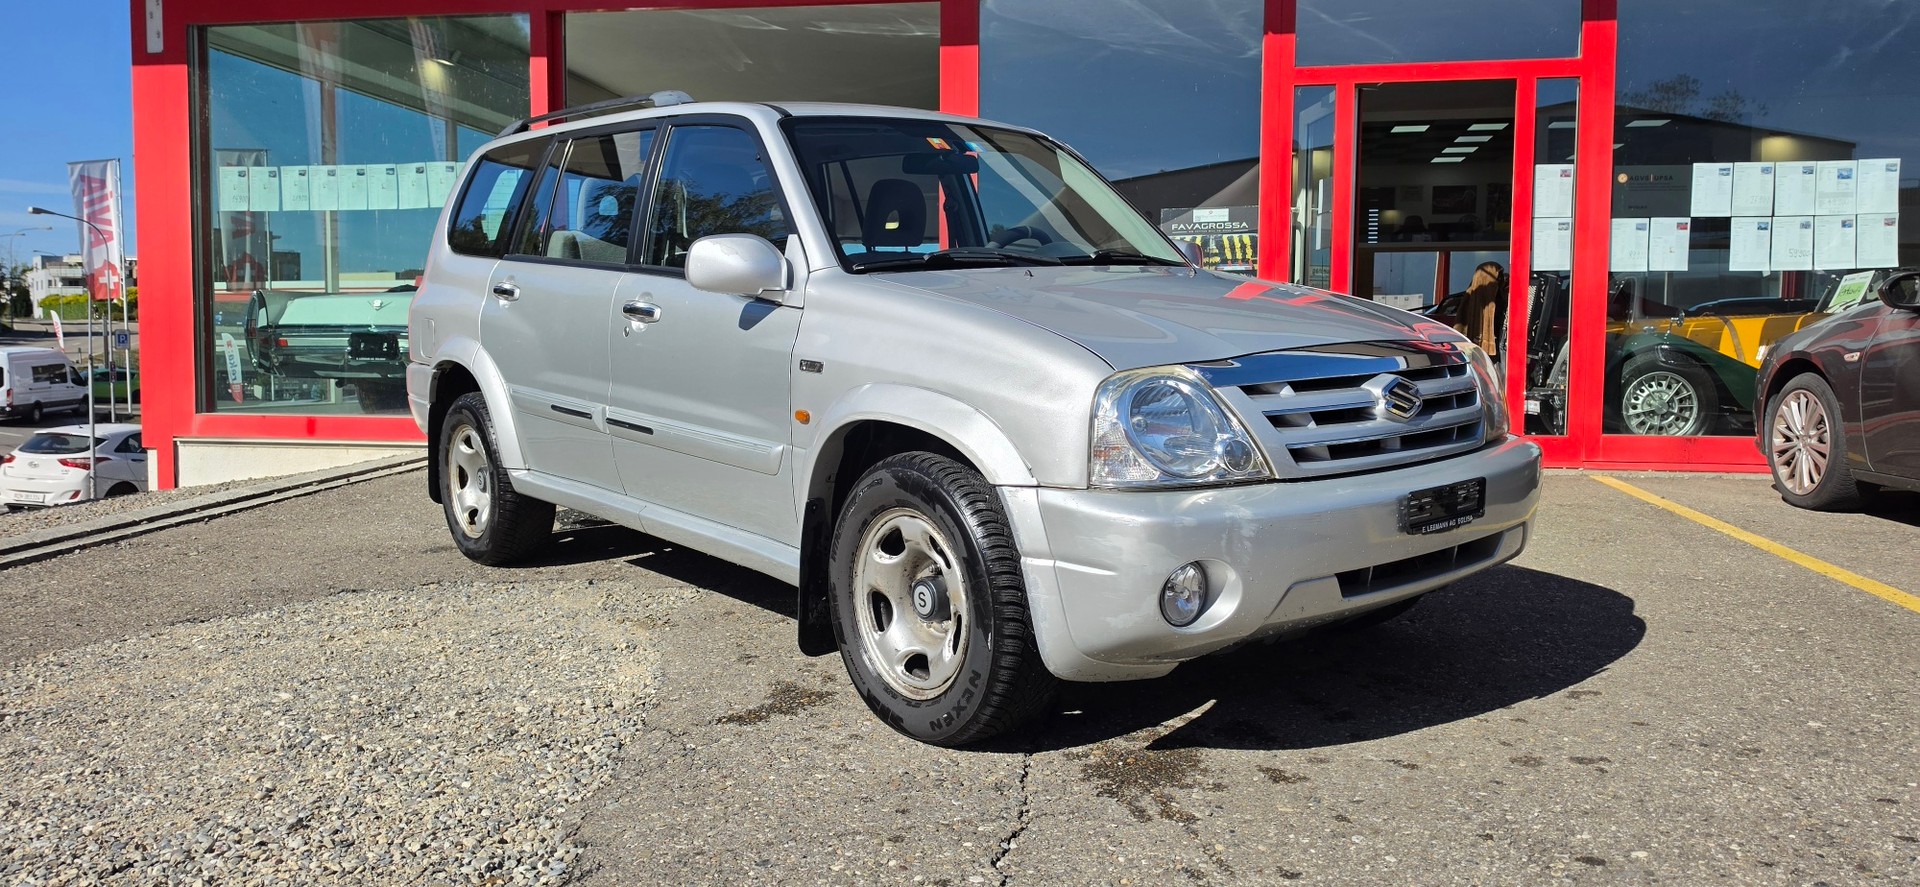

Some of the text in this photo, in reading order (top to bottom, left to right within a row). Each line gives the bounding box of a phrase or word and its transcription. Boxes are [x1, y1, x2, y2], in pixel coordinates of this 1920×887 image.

[1171, 222, 1249, 230] FAVAGROSSA
[918, 591, 926, 608] S
[929, 669, 981, 731] NEXEN
